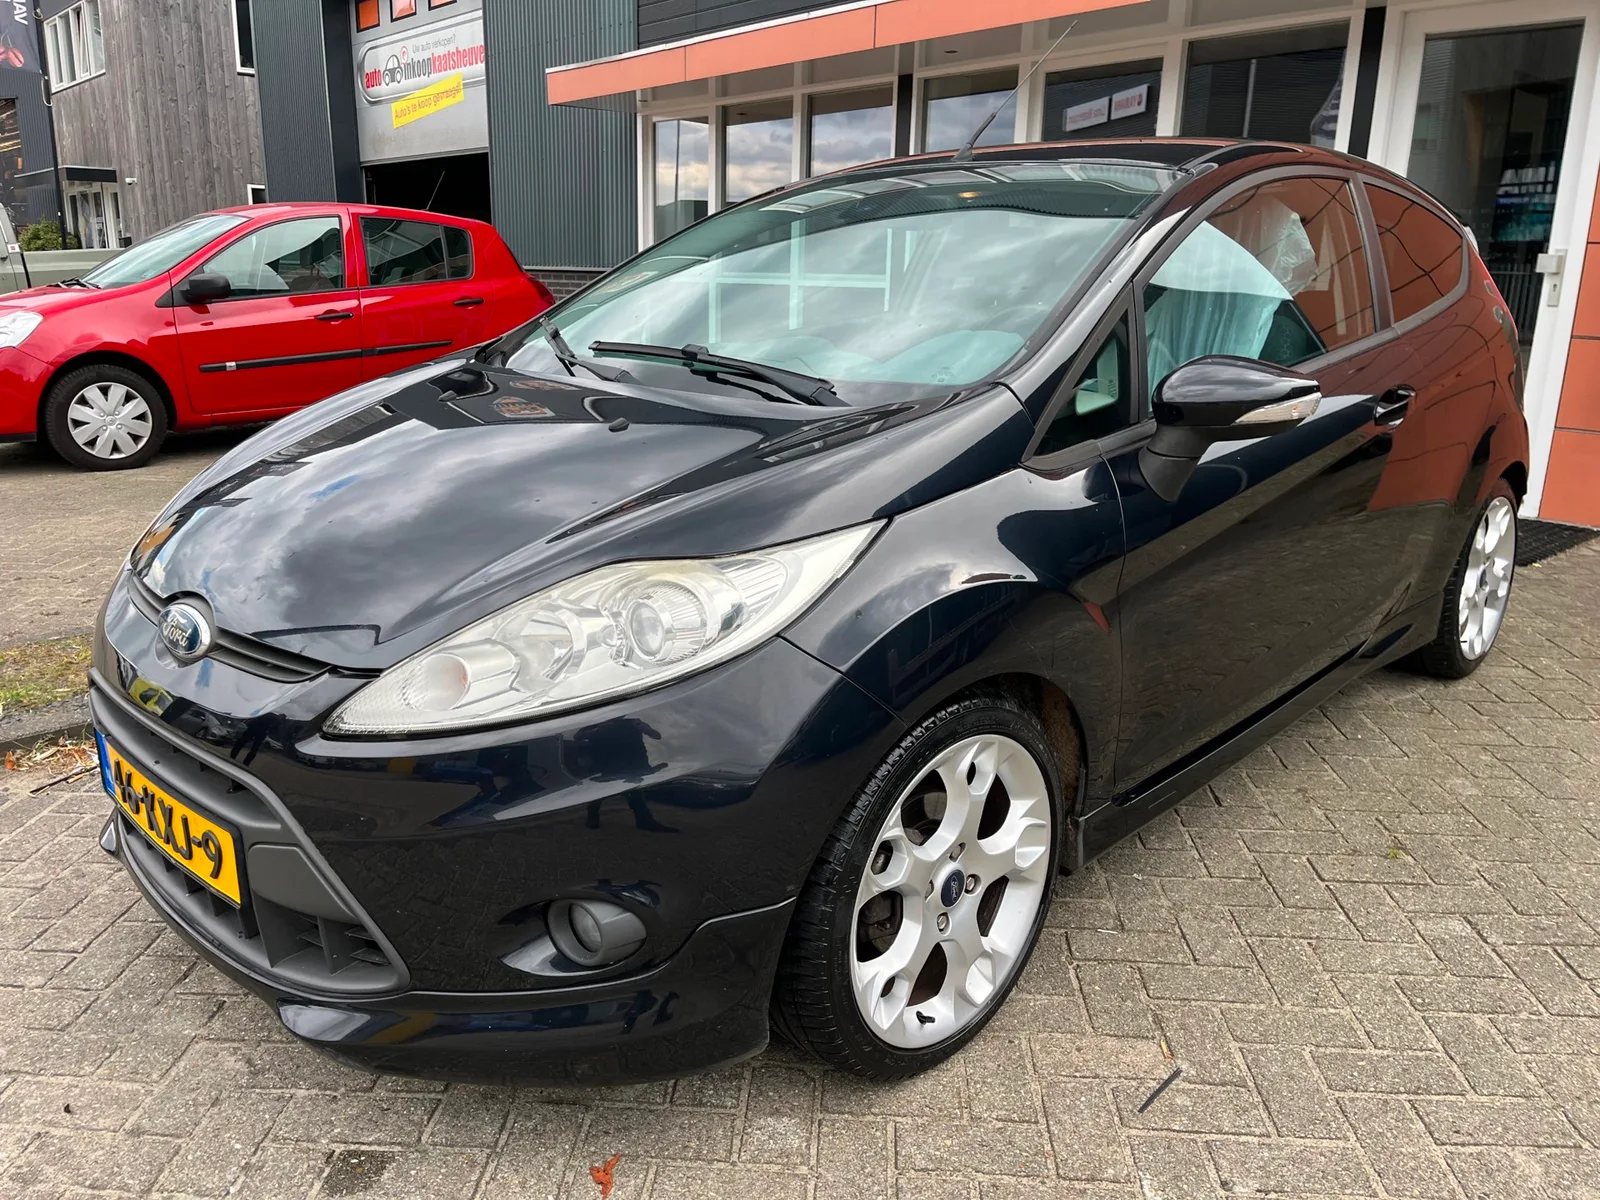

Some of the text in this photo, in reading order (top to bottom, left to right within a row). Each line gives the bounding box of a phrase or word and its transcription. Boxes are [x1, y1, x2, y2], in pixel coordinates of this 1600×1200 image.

[365, 68, 383, 89] auto
[417, 97, 432, 112] koop
[162, 610, 192, 647] Ford
